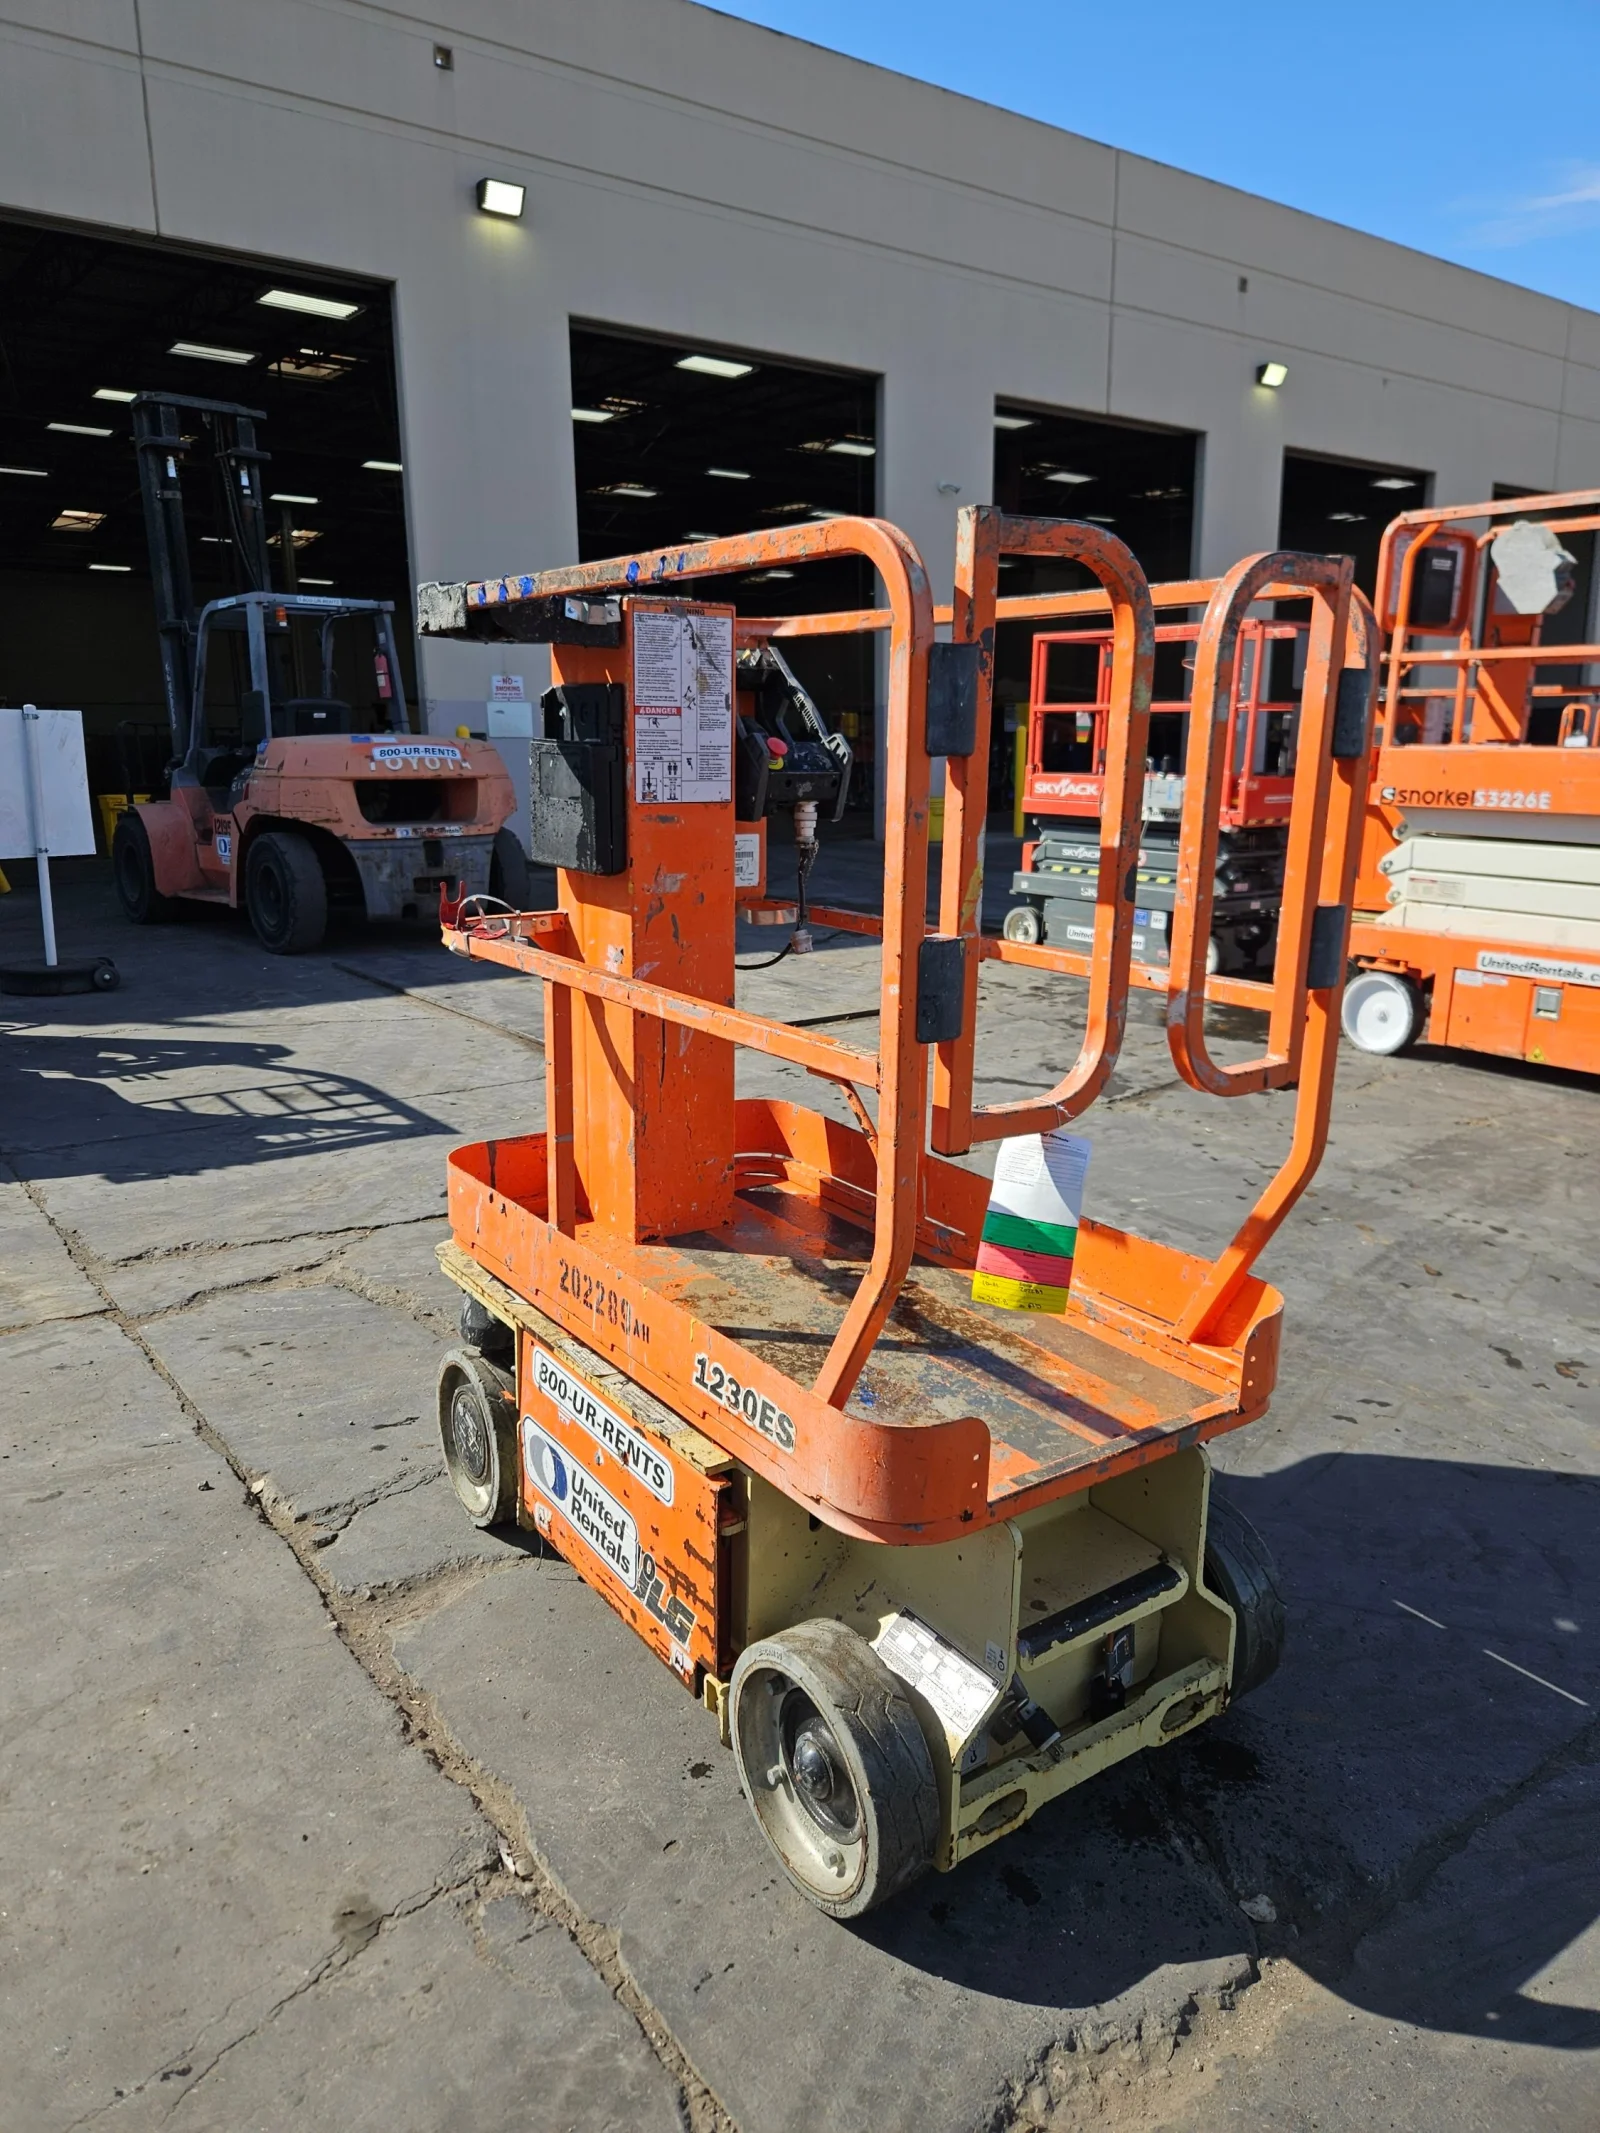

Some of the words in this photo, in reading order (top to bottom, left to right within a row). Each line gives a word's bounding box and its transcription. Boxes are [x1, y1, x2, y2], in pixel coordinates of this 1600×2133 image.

[645, 707, 677, 715] DANGER
[379, 747, 458, 758] 800-UR-RENTS
[1034, 778, 1098, 797] SKYJACK
[1399, 788, 1476, 807] snorkel
[1473, 788, 1552, 810] S3226E
[539, 1362, 666, 1489] 800-UR-RENTS
[695, 1355, 796, 1451] 1230ES
[571, 1470, 626, 1542] United
[571, 1495, 630, 1574] Rentals
